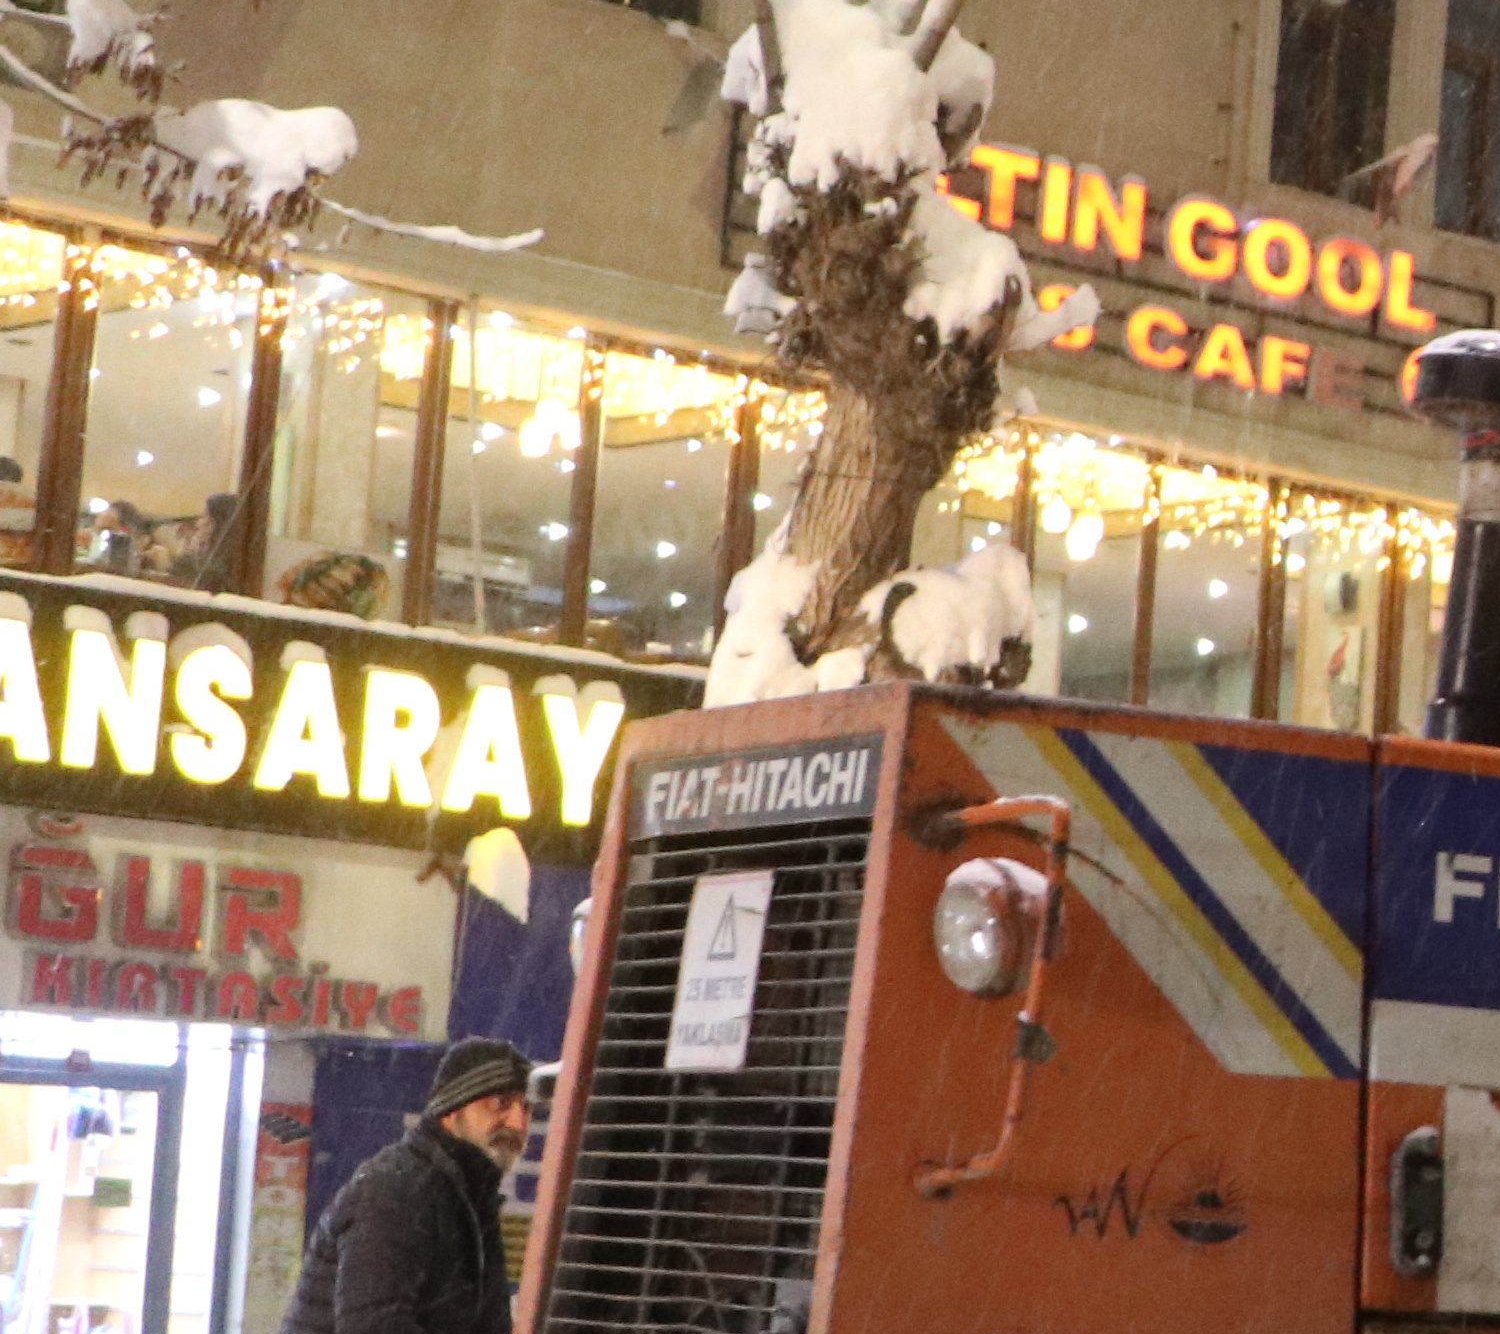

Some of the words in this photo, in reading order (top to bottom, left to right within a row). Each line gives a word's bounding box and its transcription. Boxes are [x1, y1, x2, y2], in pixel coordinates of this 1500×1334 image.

[1167, 197, 1437, 331] GOOL
[1126, 304, 1366, 411] CAFE
[645, 748, 870, 822] FIAT-HITACHI
